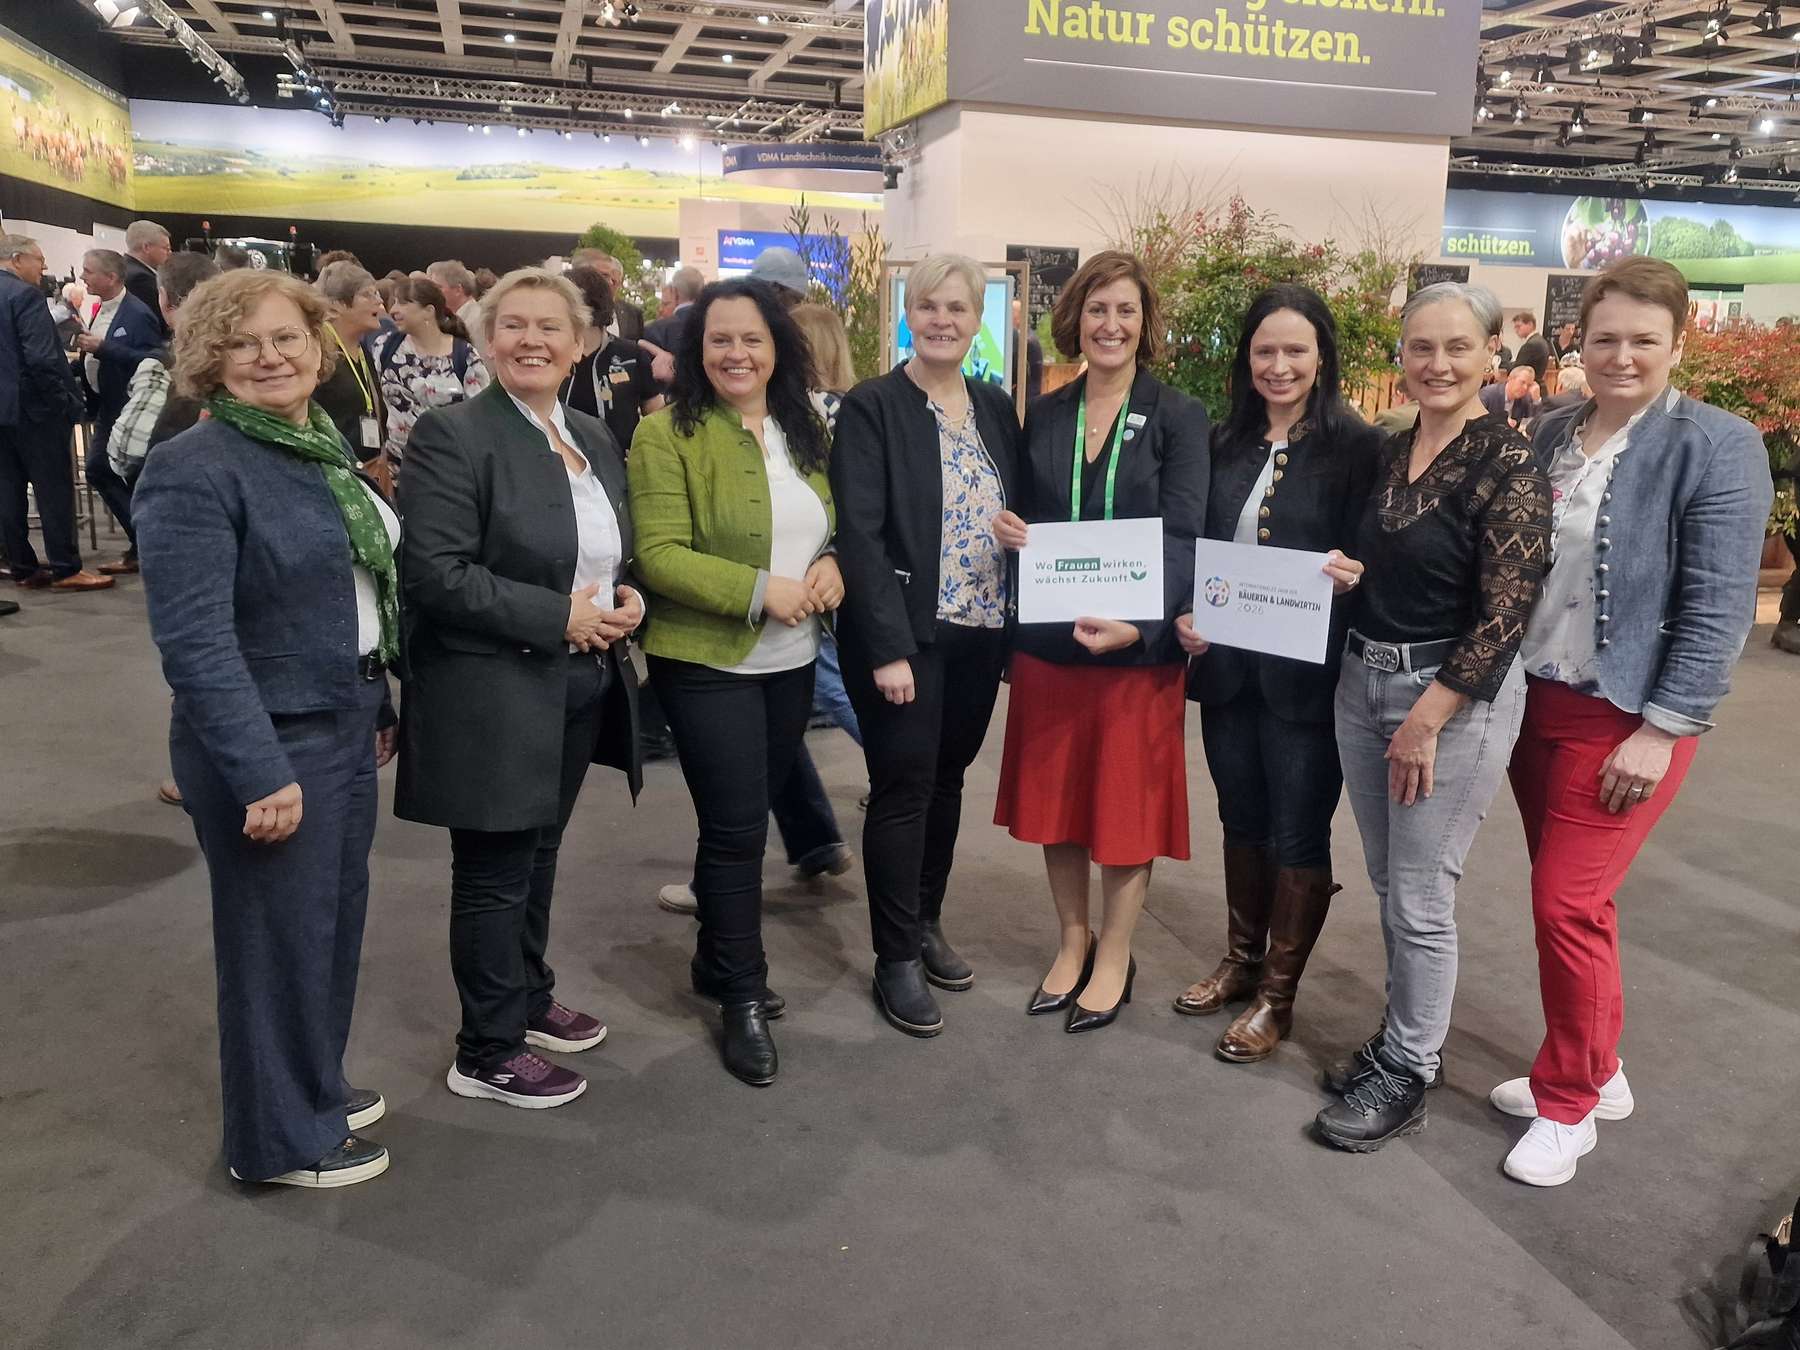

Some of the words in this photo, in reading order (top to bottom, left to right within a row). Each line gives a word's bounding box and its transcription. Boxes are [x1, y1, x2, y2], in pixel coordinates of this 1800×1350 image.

[1024, 0, 1155, 44] Natur
[1167, 8, 1371, 64] schützen.
[756, 152, 780, 163] VDMA
[1447, 232, 1535, 256] schützen.
[1035, 562, 1053, 571] Wo
[1057, 560, 1098, 571] Frauen
[1034, 575, 1076, 584] wächst
[1081, 574, 1132, 584] Zukunft.
[1238, 590, 1268, 603] BÄUERIN
[1269, 595, 1276, 604] &
[1276, 596, 1322, 612] LANDWIRTIN
[1237, 603, 1264, 616] 2026
